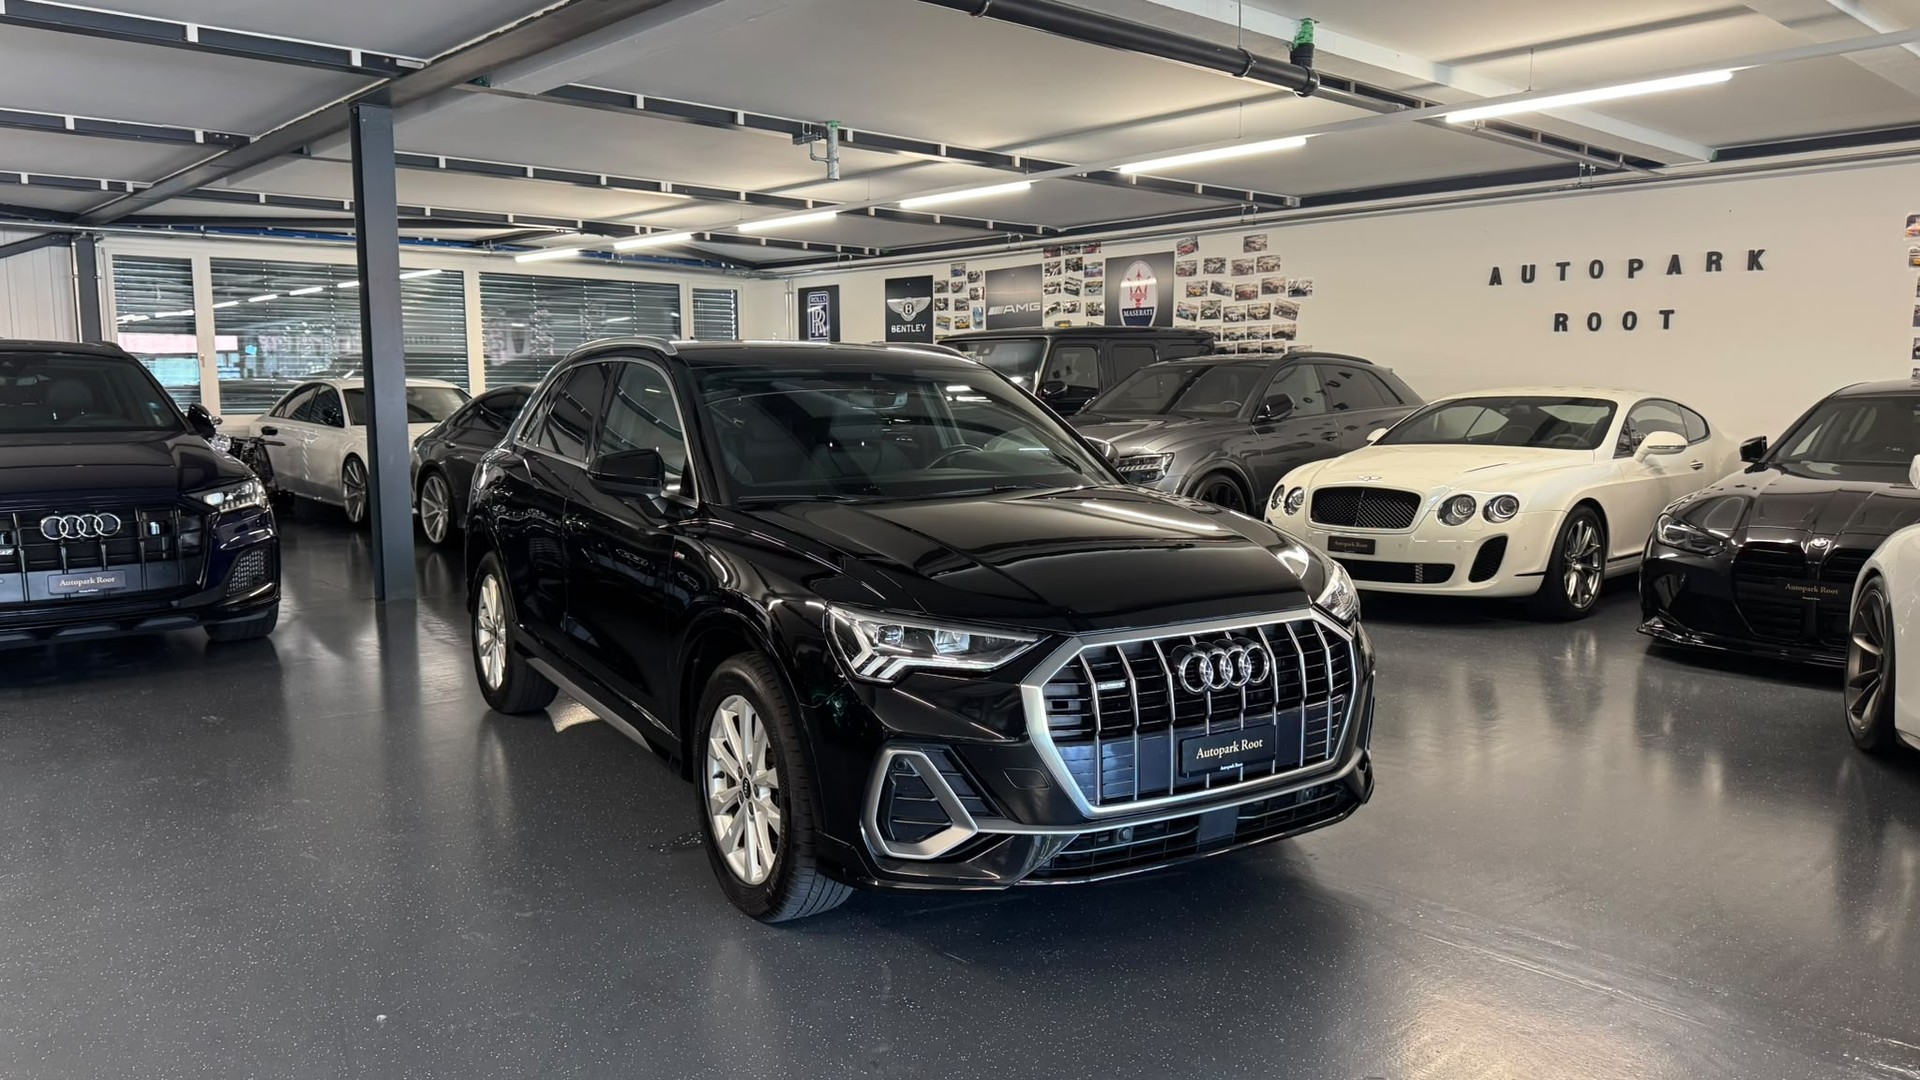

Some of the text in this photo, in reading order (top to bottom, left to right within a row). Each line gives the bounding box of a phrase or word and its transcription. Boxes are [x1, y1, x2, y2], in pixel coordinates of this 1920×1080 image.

[1489, 249, 1766, 286] AUTOPARK
[1003, 302, 1041, 314] AMG
[1123, 308, 1153, 317] MASERATI
[1553, 309, 1675, 332] ROOT
[891, 323, 927, 333] BENTLEY
[59, 576, 115, 587] Autopark Root
[1785, 583, 1839, 595] Autopark Root
[1196, 738, 1263, 760] Autopark Root
